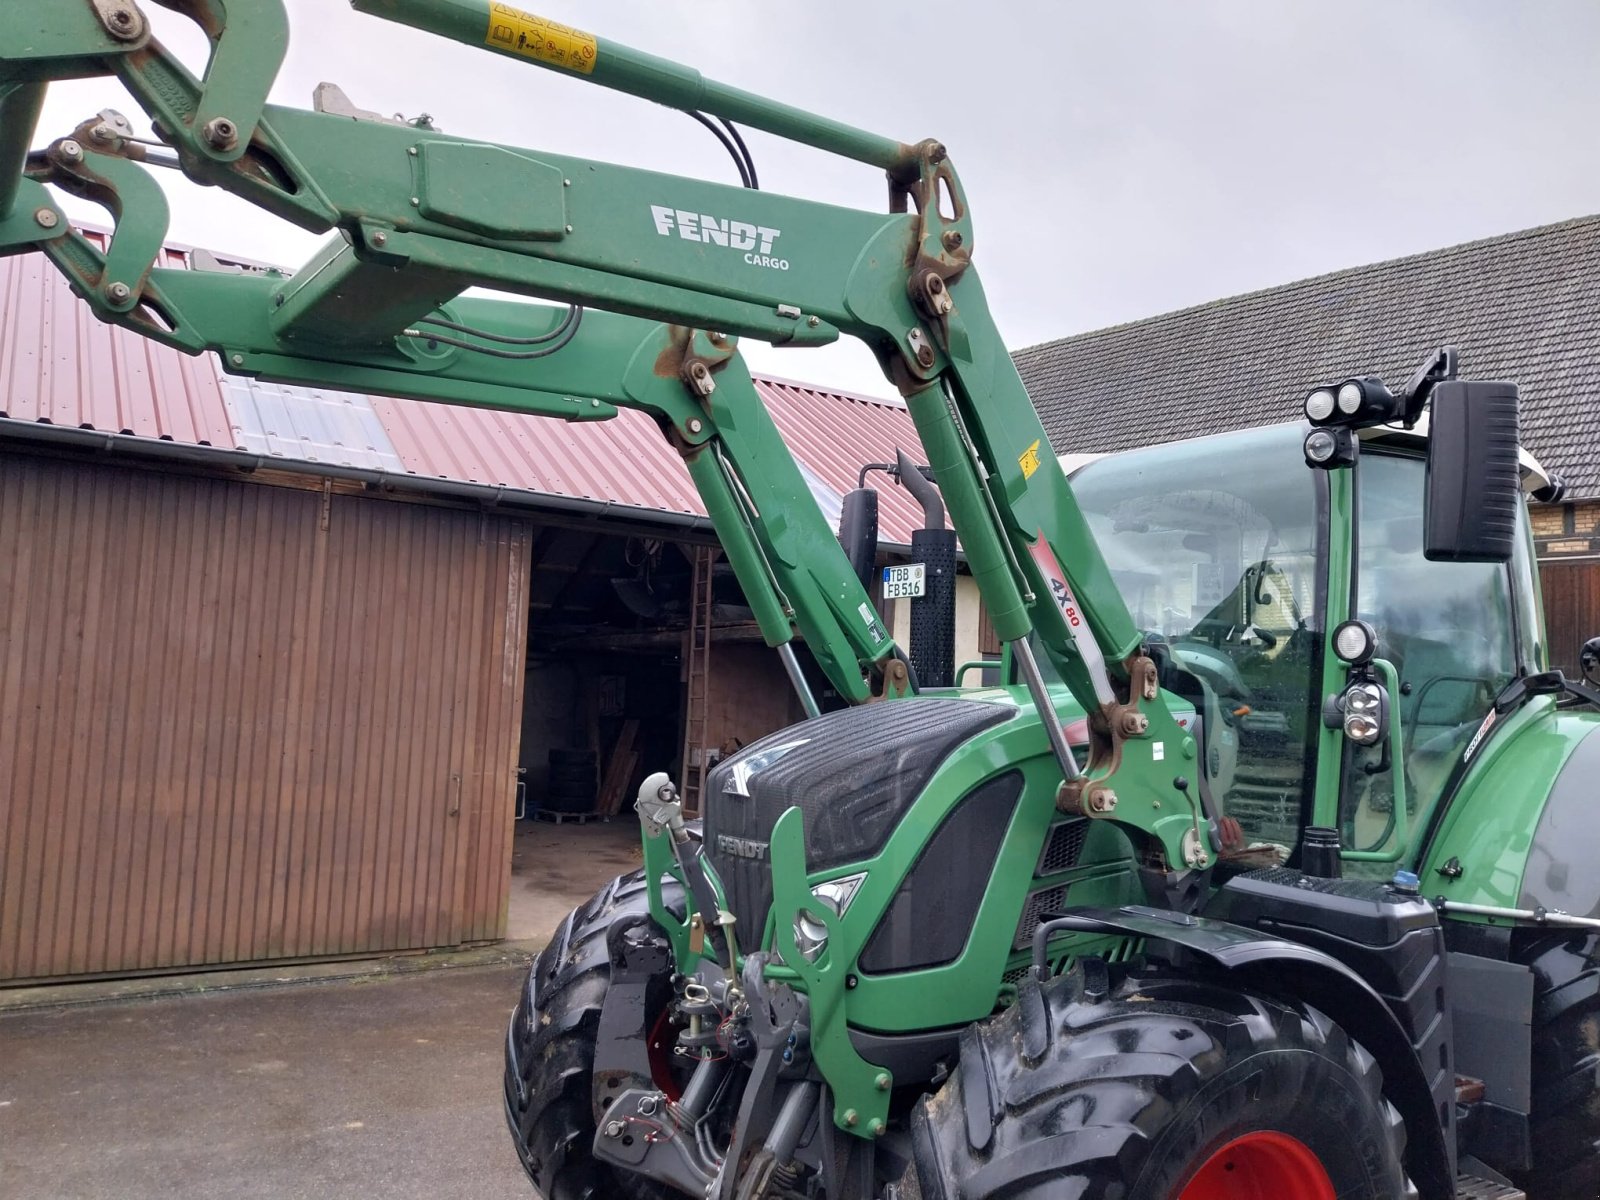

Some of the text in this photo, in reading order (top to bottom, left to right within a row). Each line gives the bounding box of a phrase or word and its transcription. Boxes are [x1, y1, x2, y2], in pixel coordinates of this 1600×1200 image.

[650, 204, 781, 254] FENDT
[744, 253, 789, 270] CARGO
[891, 568, 909, 582] TBB
[888, 581, 920, 597] FB 516
[718, 834, 769, 859] FENDT
